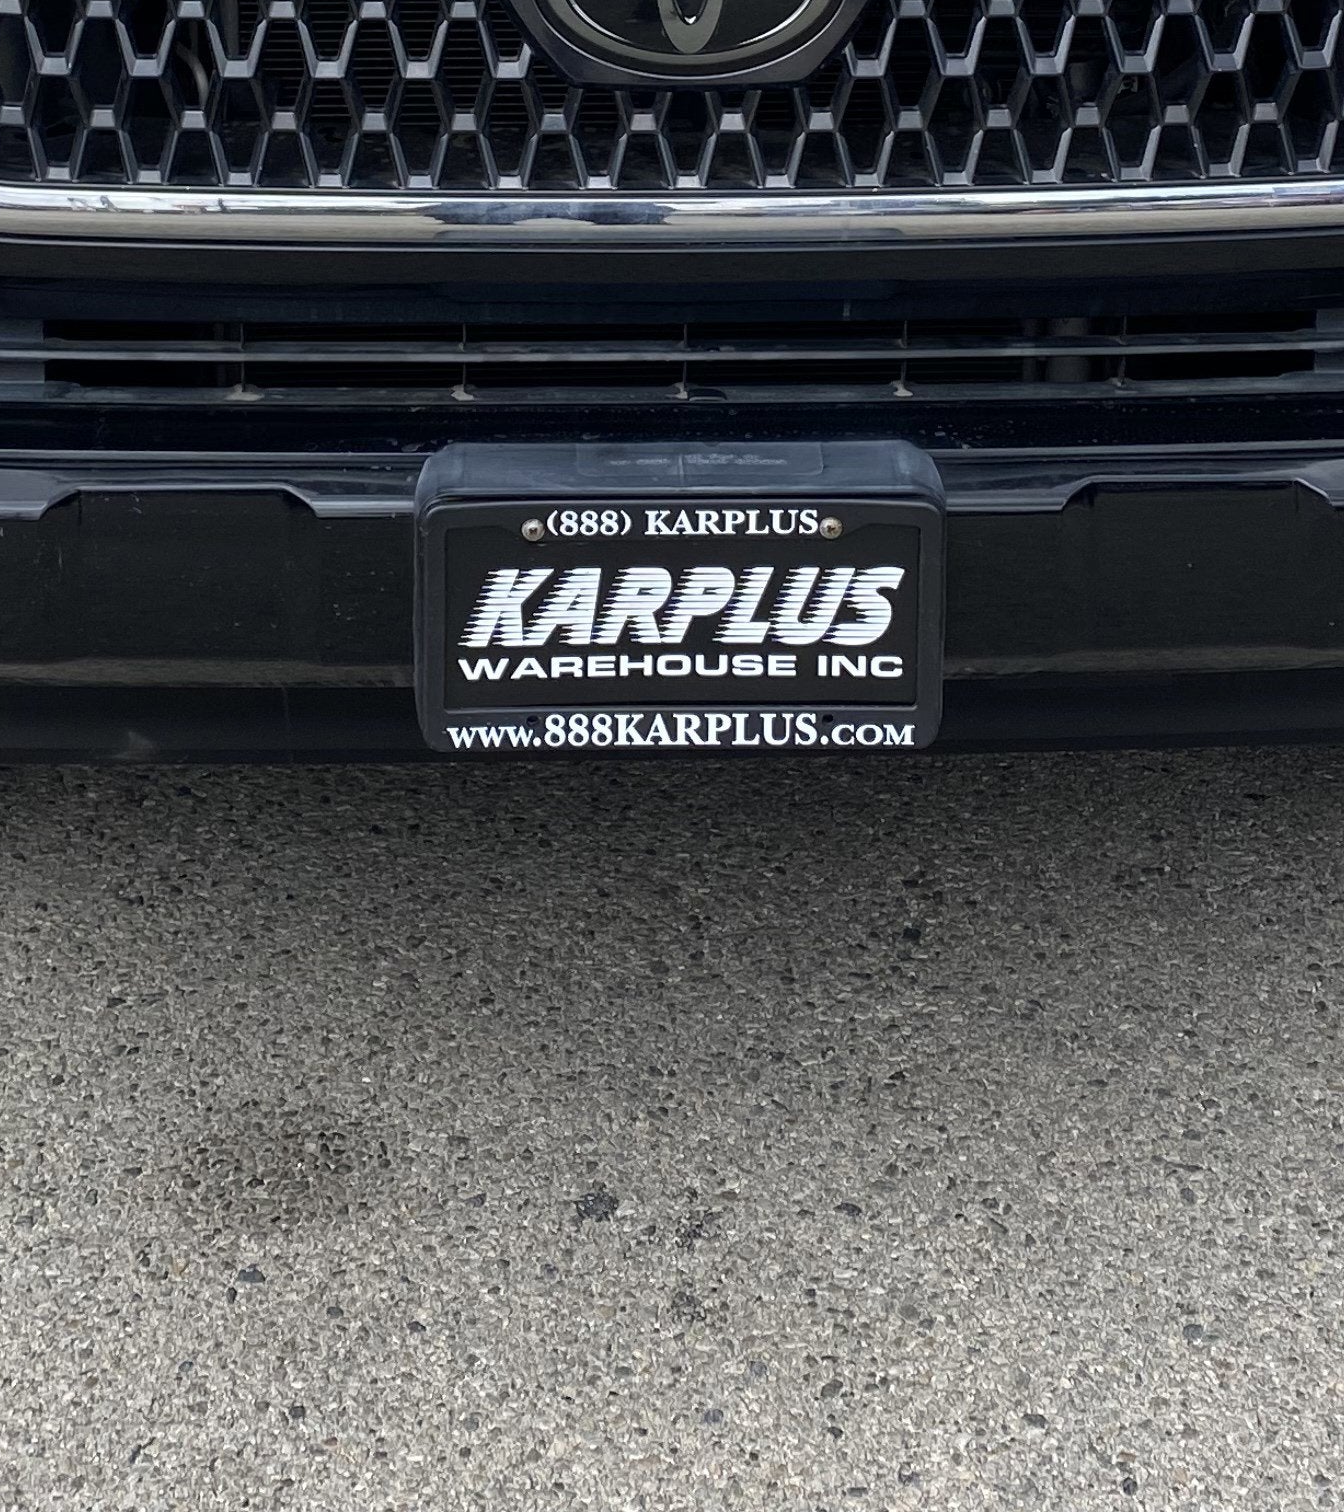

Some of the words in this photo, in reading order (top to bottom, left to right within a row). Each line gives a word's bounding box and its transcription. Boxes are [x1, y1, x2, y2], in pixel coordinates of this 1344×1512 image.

[546, 509, 632, 536] (888)
[644, 509, 819, 536] KARPLUS
[457, 566, 905, 648] KARPLUS
[457, 654, 797, 681] WAREHOUSE
[817, 654, 904, 678] INC
[445, 711, 916, 749] www.888KARPLUS.COM
